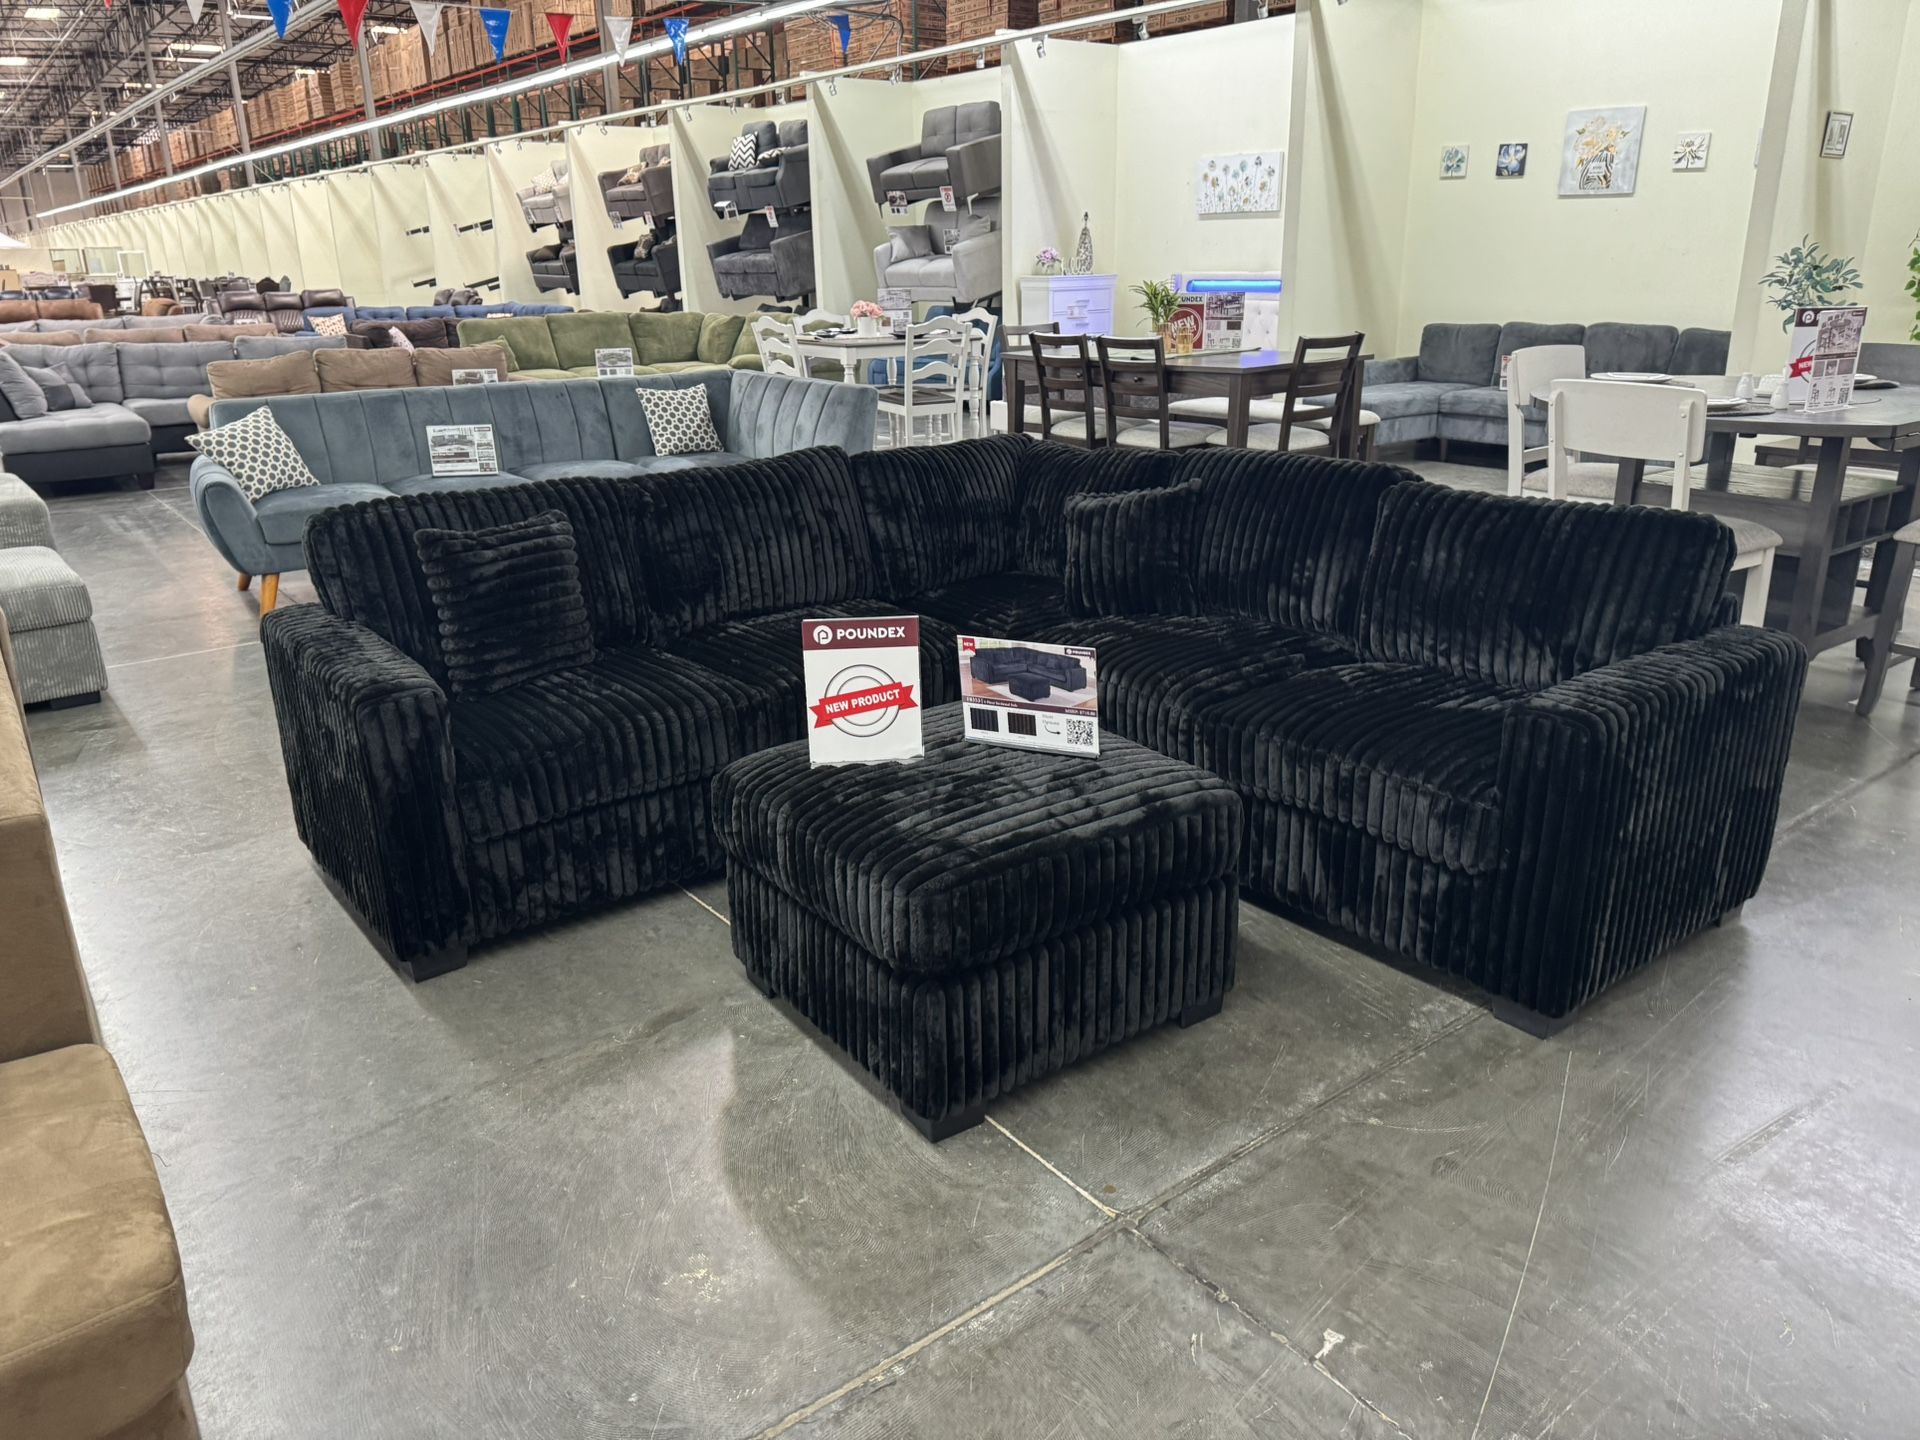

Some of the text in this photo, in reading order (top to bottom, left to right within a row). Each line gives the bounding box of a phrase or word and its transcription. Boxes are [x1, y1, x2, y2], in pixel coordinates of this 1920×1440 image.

[1171, 314, 1195, 333] NEW
[836, 626, 906, 640] POUNDEX
[825, 689, 901, 714] NEW PRODUCT
